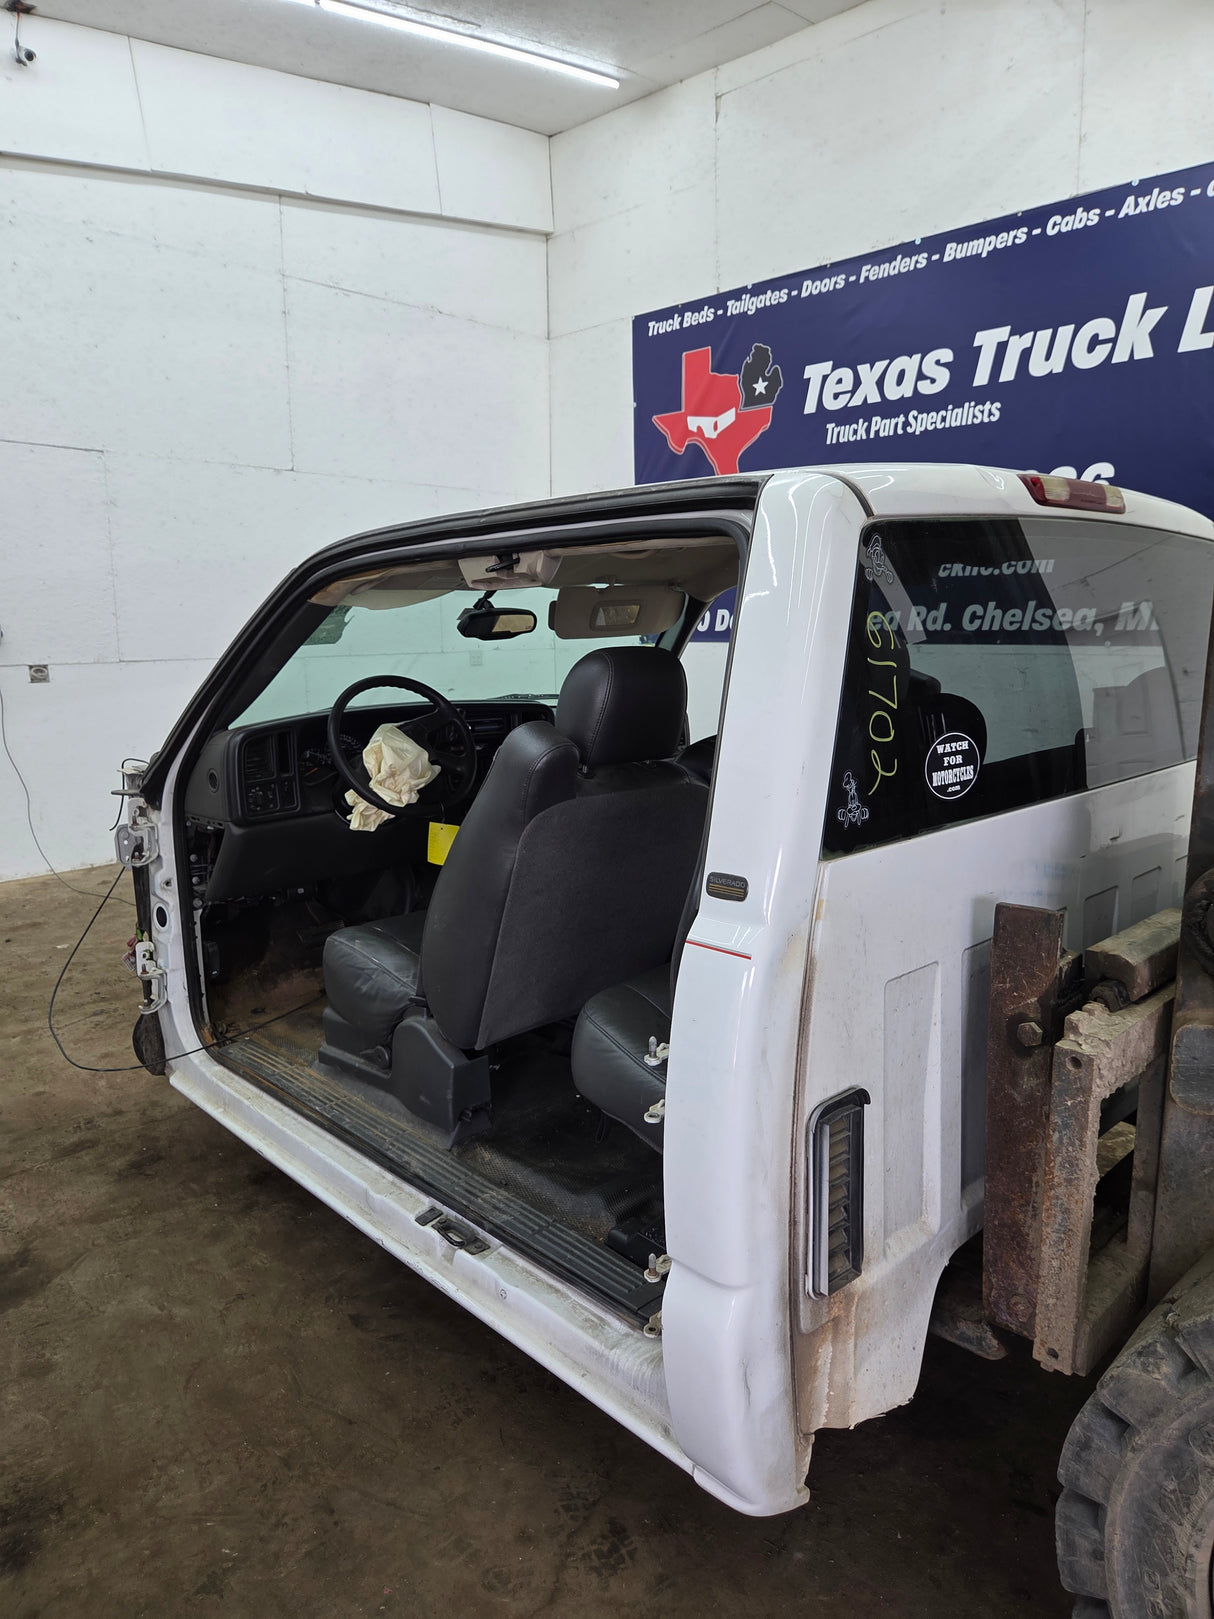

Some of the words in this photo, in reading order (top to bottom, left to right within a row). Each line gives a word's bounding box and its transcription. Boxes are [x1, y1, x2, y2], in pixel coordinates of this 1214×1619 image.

[648, 313, 682, 337] Truck
[683, 305, 714, 328] Beds
[727, 288, 789, 317] Tailgates
[800, 273, 846, 298] Doors
[859, 253, 929, 284] Fenders
[943, 226, 1029, 263] Bumpers
[1046, 206, 1101, 237] Cabs
[1117, 187, 1186, 219] Axles
[803, 348, 954, 415] Texas
[972, 291, 1169, 387] Truck
[826, 418, 868, 445] Truck
[870, 413, 905, 439] Part
[906, 400, 1002, 435] Specialists
[907, 602, 952, 631] Rd.
[961, 600, 1104, 637] Chelsea,
[936, 740, 970, 754] WATCH
[943, 754, 963, 767] FOR
[932, 765, 975, 787] MOTORCYCLES
[709, 875, 746, 889] SILVERADO
